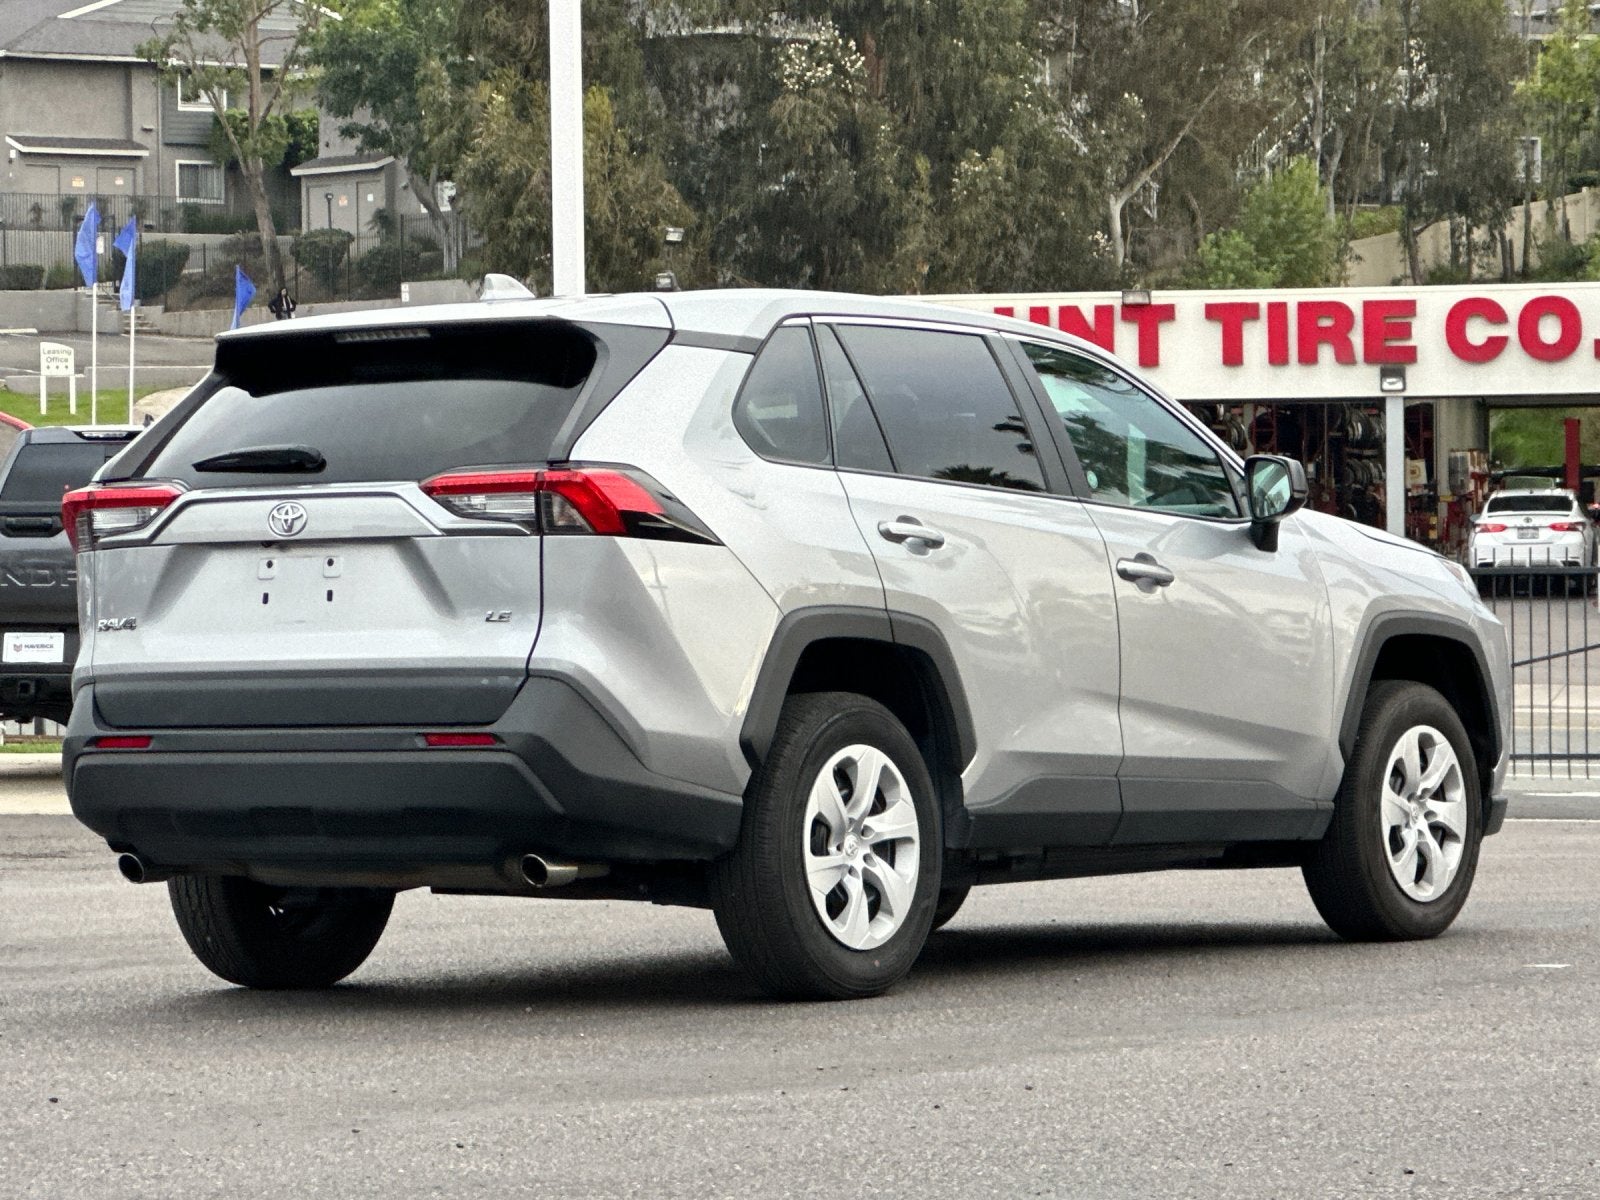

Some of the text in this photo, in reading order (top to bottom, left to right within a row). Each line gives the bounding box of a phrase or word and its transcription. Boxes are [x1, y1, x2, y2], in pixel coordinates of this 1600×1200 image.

[994, 303, 1176, 367] NT
[1204, 299, 1418, 366] TIRE
[43, 347, 72, 356] Leasing
[485, 610, 512, 622] LE
[97, 616, 137, 632] RAV4
